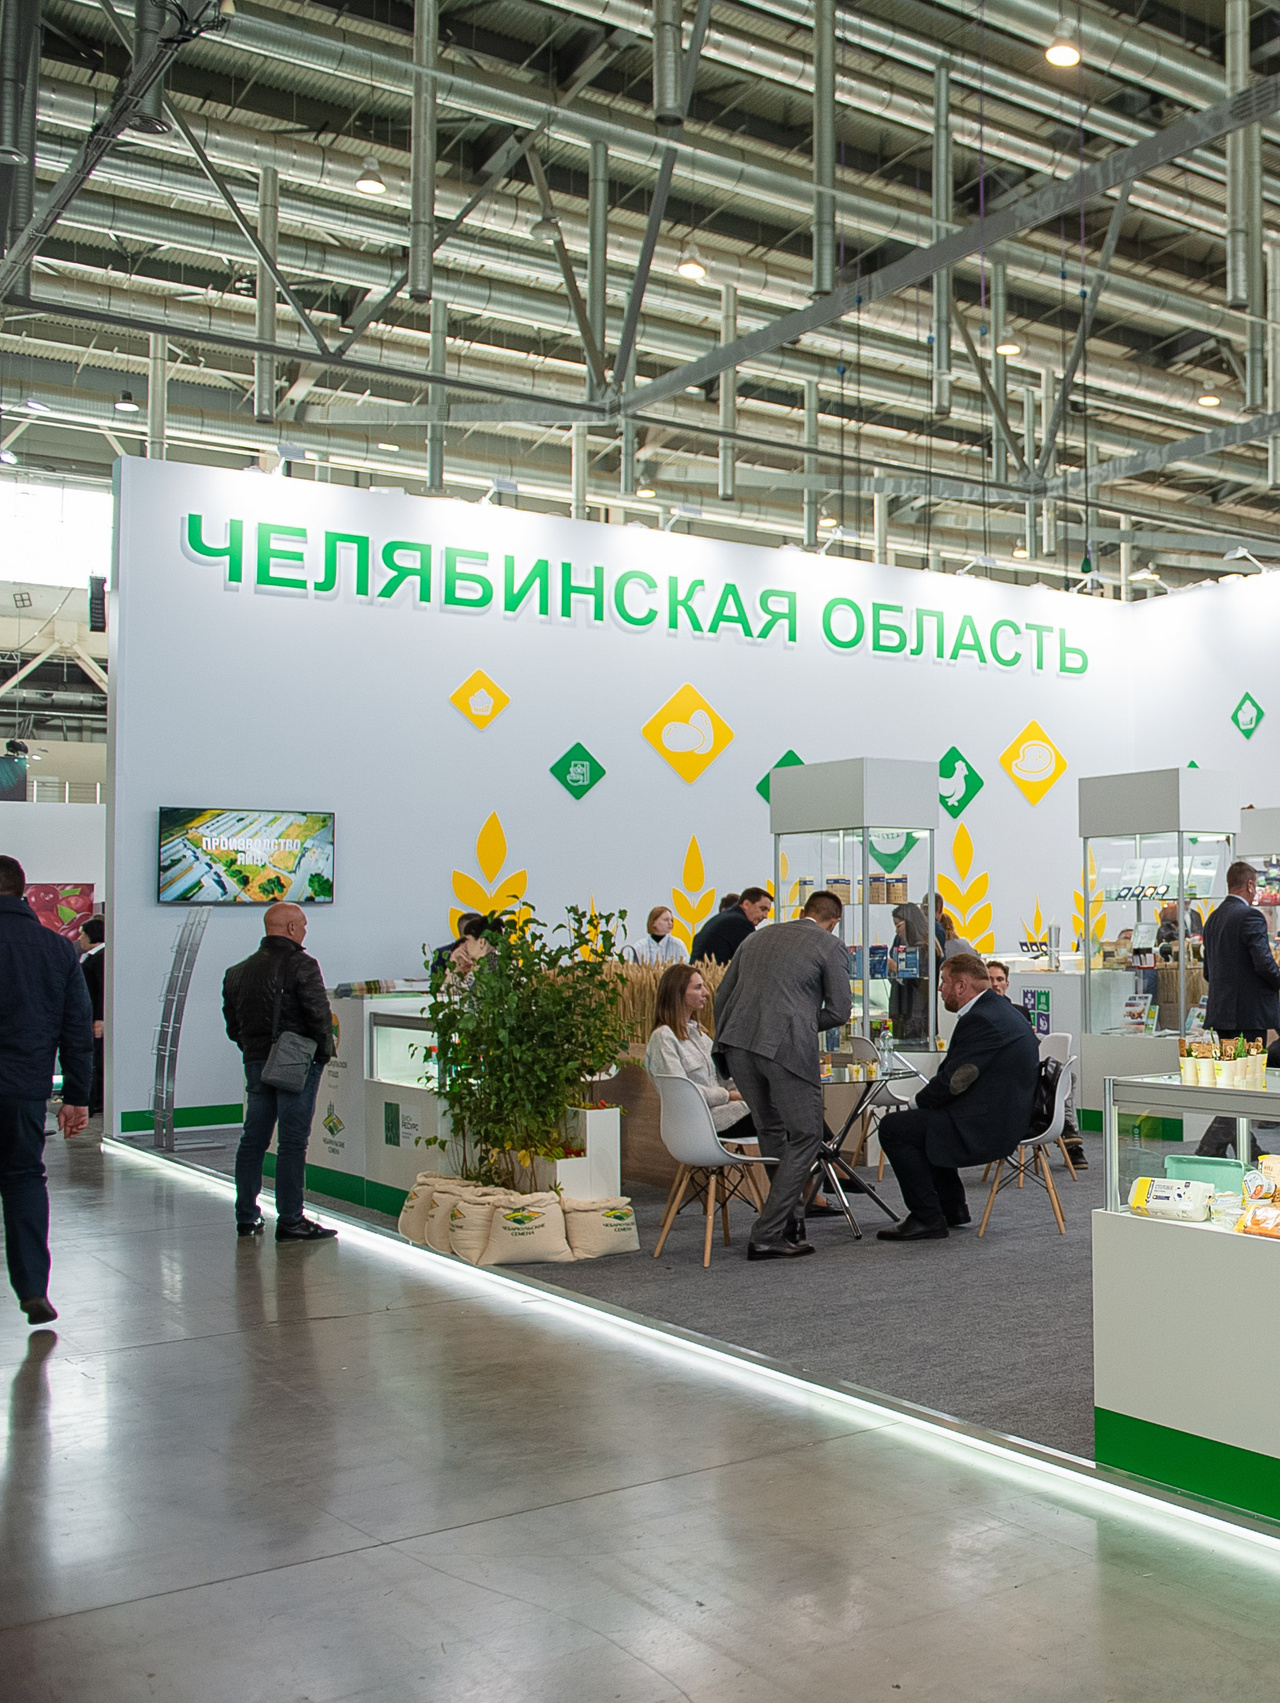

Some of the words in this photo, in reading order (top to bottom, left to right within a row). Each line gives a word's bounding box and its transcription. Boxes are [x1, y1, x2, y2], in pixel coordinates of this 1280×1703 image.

[187, 512, 798, 643] ЧЕЛЯБИНСКАЯ
[821, 597, 1090, 676] ОБЛАСТЬ
[202, 837, 301, 851] ПРОИЗВОДСТВО
